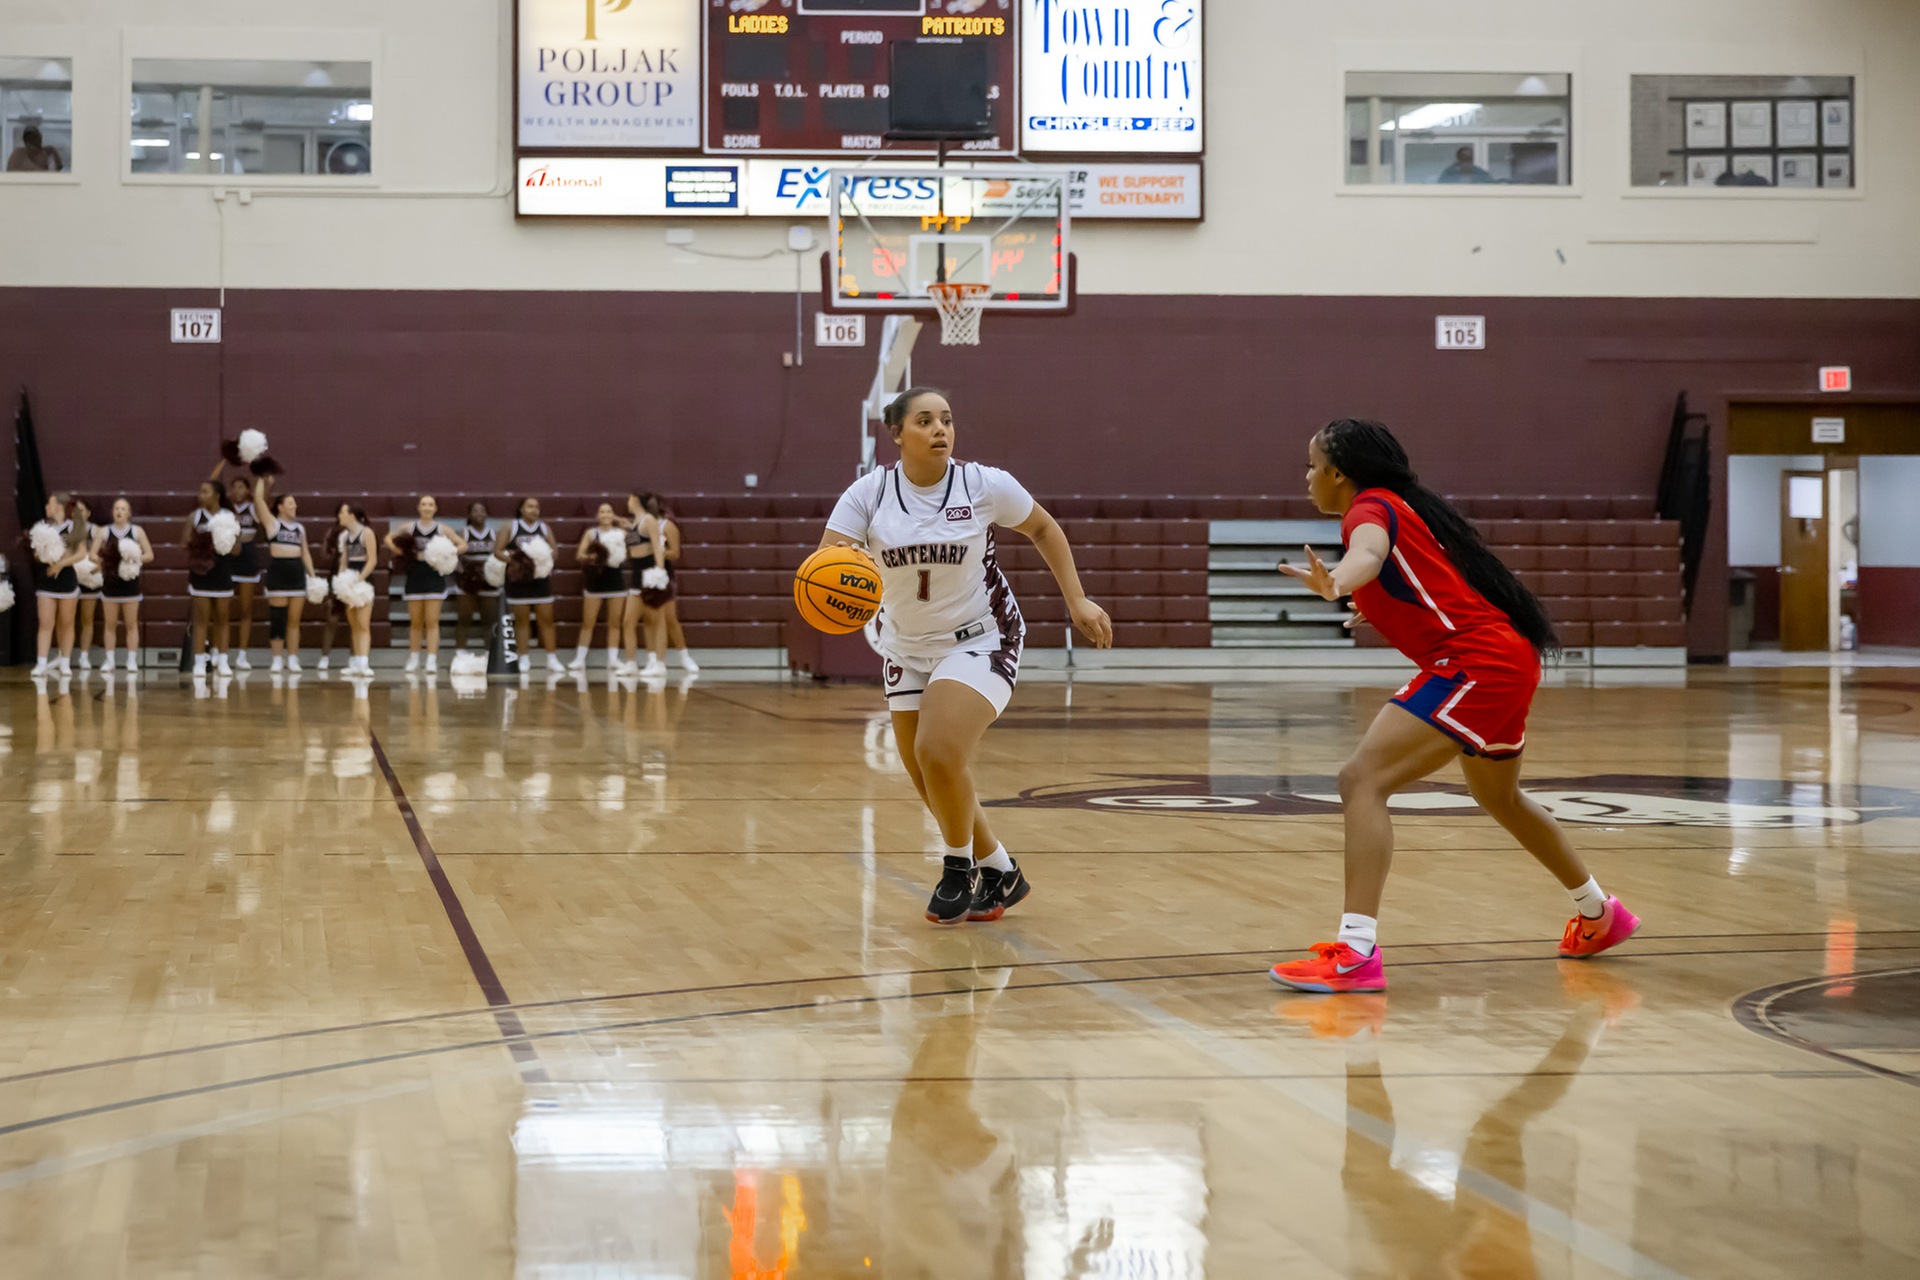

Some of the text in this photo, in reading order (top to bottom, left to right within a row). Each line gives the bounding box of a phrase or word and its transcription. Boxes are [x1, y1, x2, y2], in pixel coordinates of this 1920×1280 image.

[728, 15, 788, 34] LADIES
[922, 16, 1005, 35] PATRIOTS
[1034, 0, 1129, 53] Town
[840, 31, 883, 44] PERIOD
[538, 48, 679, 73] POLJAK
[1061, 53, 1197, 111] Country
[544, 80, 673, 107] GROUP
[721, 83, 759, 97] FOULS
[819, 84, 865, 98] PLAYER
[524, 117, 694, 126] WEALTH MANAGEMENT
[1031, 118, 1193, 130] CHRYSLER JEEP
[722, 135, 761, 148] SCORE
[841, 135, 881, 148] MATCH
[1098, 175, 1118, 189] WE
[1123, 175, 1184, 189] SUPPORT
[1016, 186, 1085, 199] Serves
[1099, 191, 1184, 205] CENTENARY!
[179, 322, 213, 338] 107
[825, 326, 857, 341] 106
[1445, 329, 1477, 345] 105
[881, 543, 969, 568] CENTENARY
[840, 572, 878, 594] NCAA
[917, 569, 931, 602] 1
[826, 594, 875, 622] Wilson
